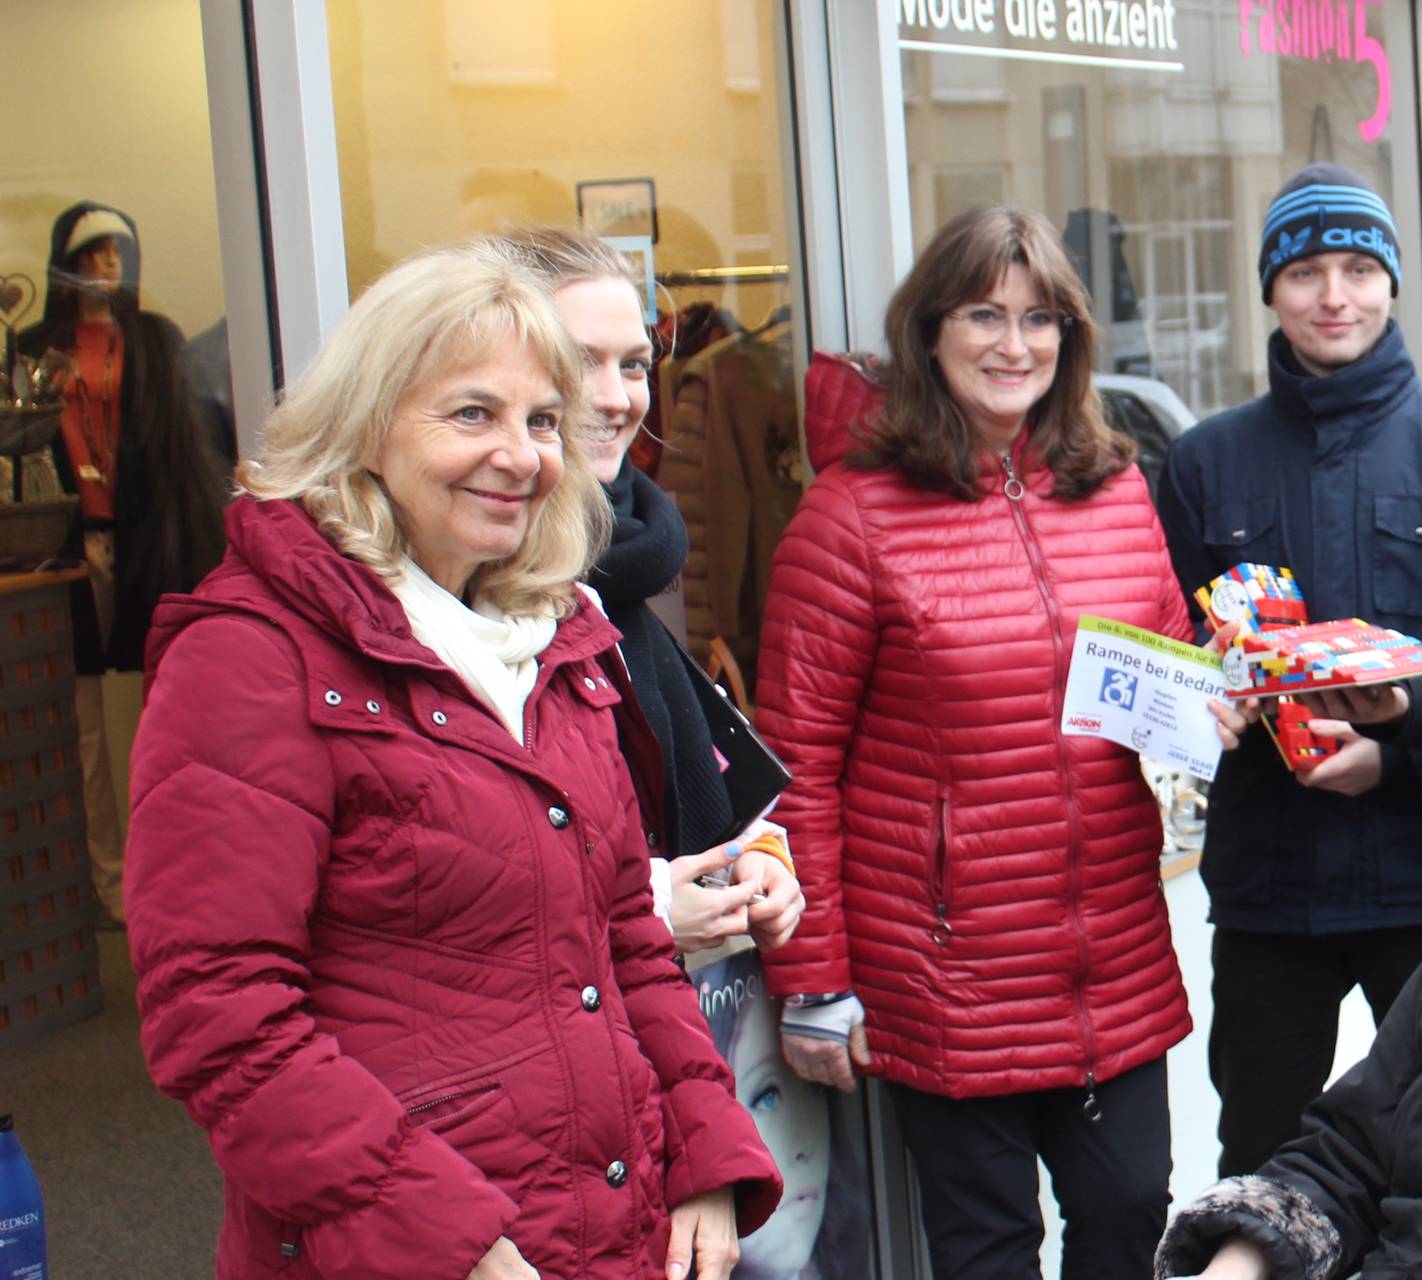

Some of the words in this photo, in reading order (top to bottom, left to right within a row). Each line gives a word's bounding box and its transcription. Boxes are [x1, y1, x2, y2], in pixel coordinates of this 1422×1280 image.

[897, 0, 995, 33] Mode
[1066, 0, 1179, 50] anzieht
[1140, 633, 1156, 645] 100
[1086, 641, 1142, 669] Rampe
[1145, 658, 1169, 680] bei
[699, 974, 763, 1017] impe
